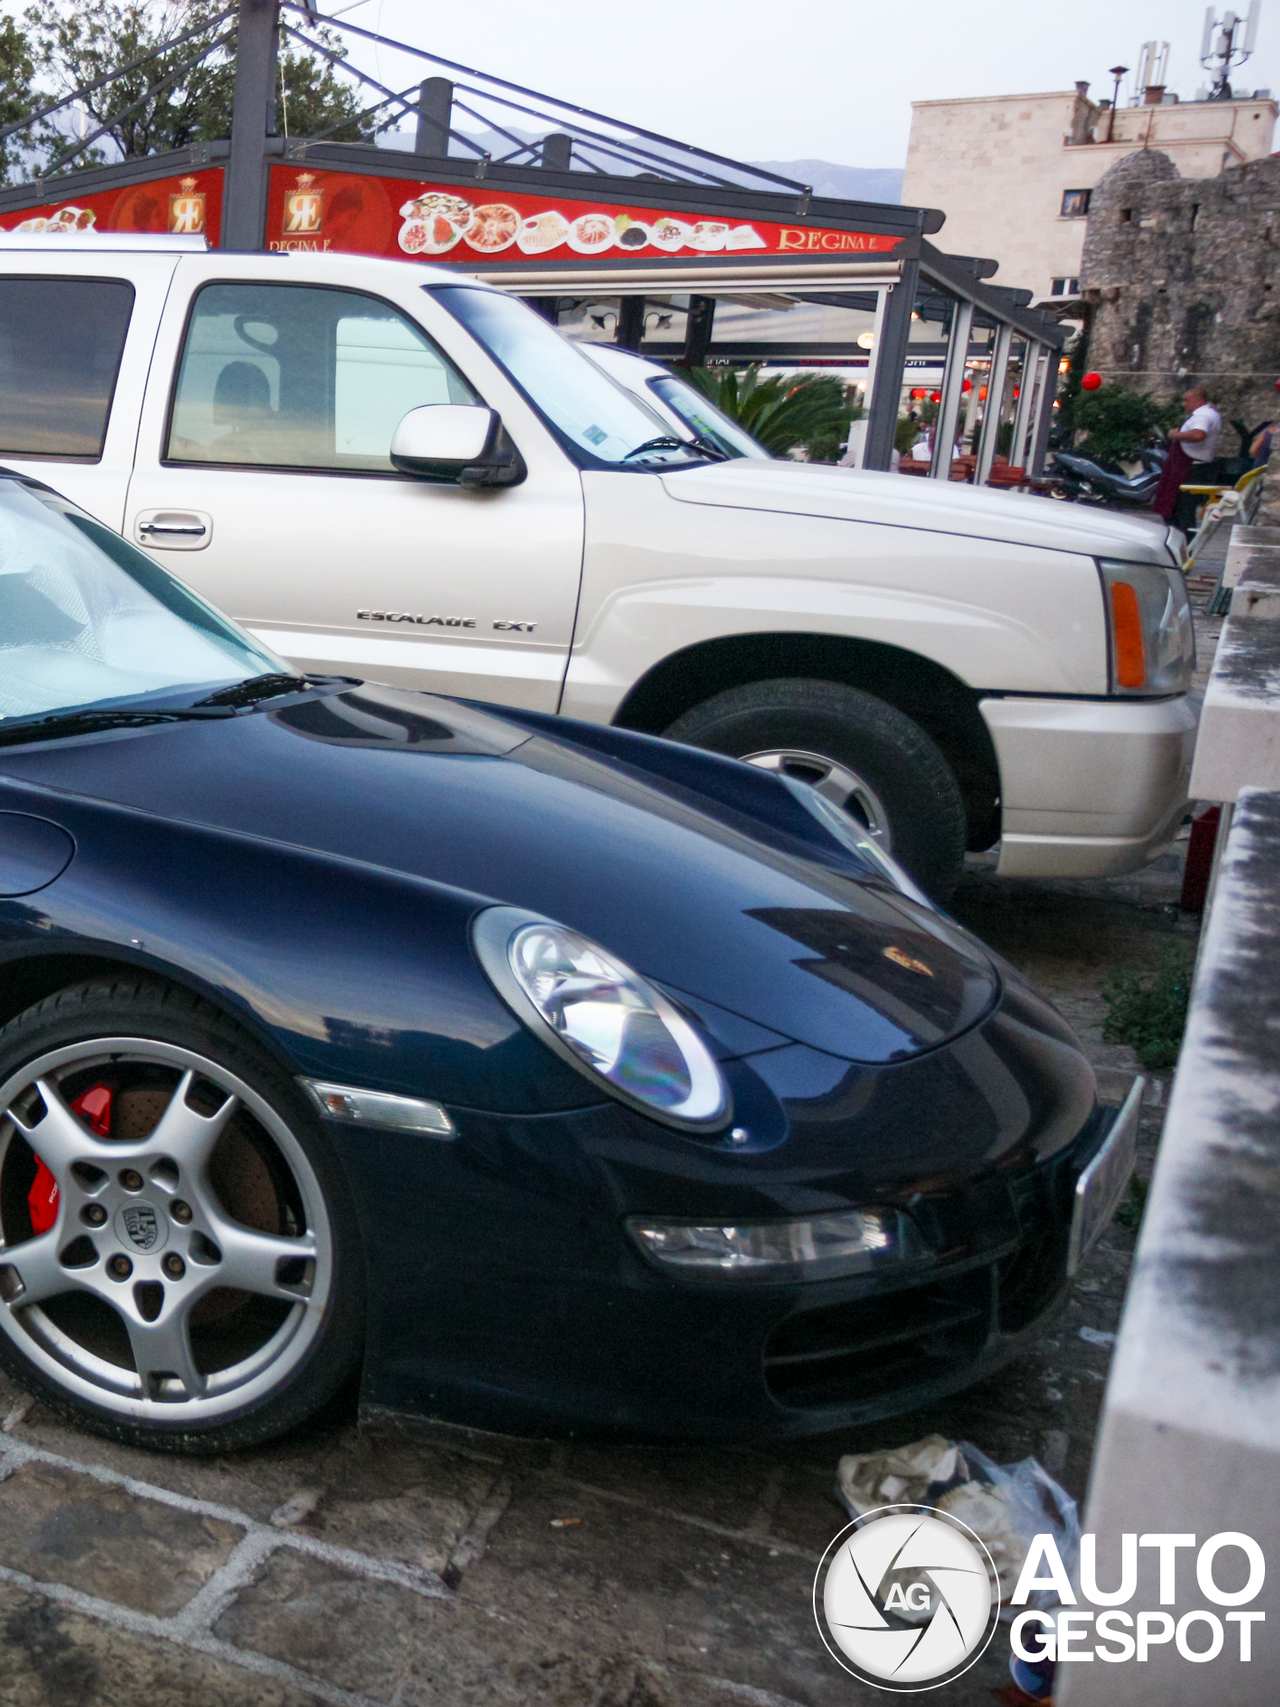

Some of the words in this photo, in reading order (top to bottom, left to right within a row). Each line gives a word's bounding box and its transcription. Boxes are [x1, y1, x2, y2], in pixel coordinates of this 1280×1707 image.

[776, 229, 864, 250] REGINA
[357, 609, 477, 629] ESCALADE
[492, 619, 538, 633] EXT
